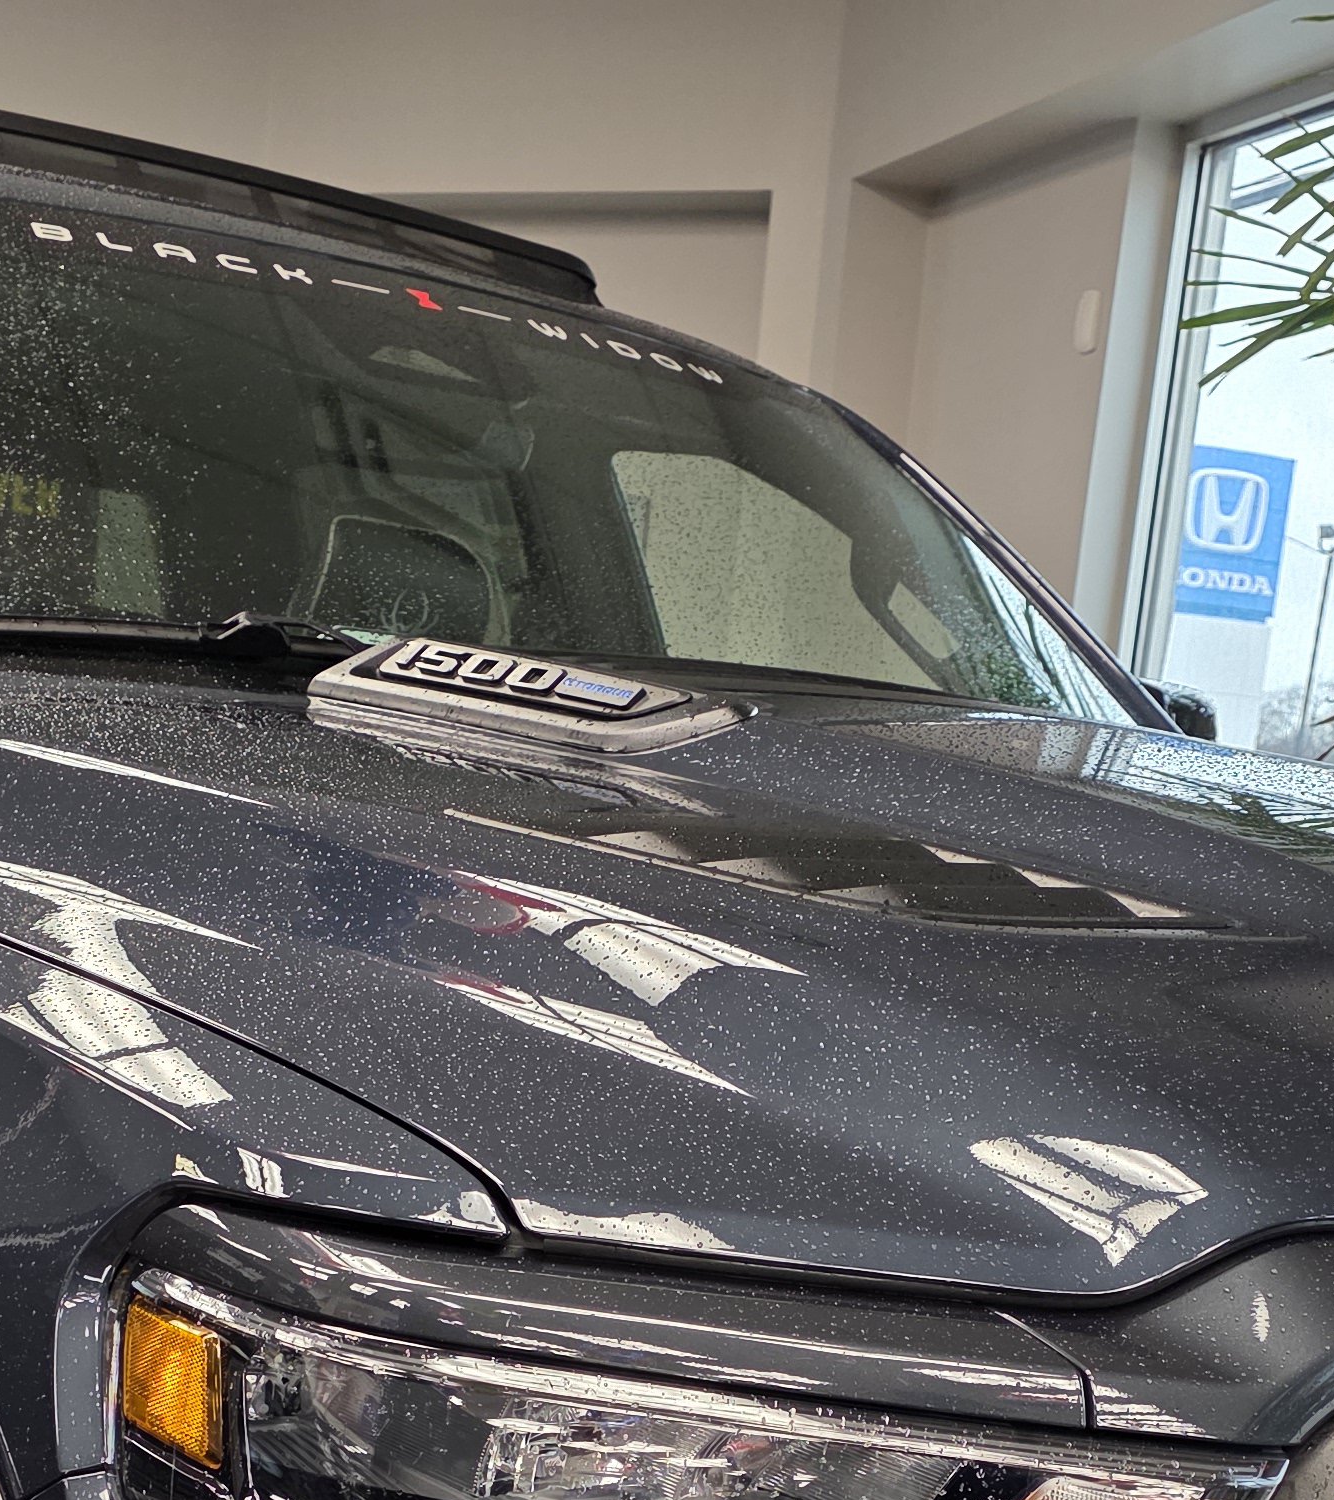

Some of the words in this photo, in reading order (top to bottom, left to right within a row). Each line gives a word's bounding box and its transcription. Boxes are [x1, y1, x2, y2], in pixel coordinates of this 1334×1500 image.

[30, 221, 314, 285] BLACK
[527, 318, 724, 385] WIDOW
[1178, 565, 1274, 598] ONDA
[395, 639, 568, 698] 1500
